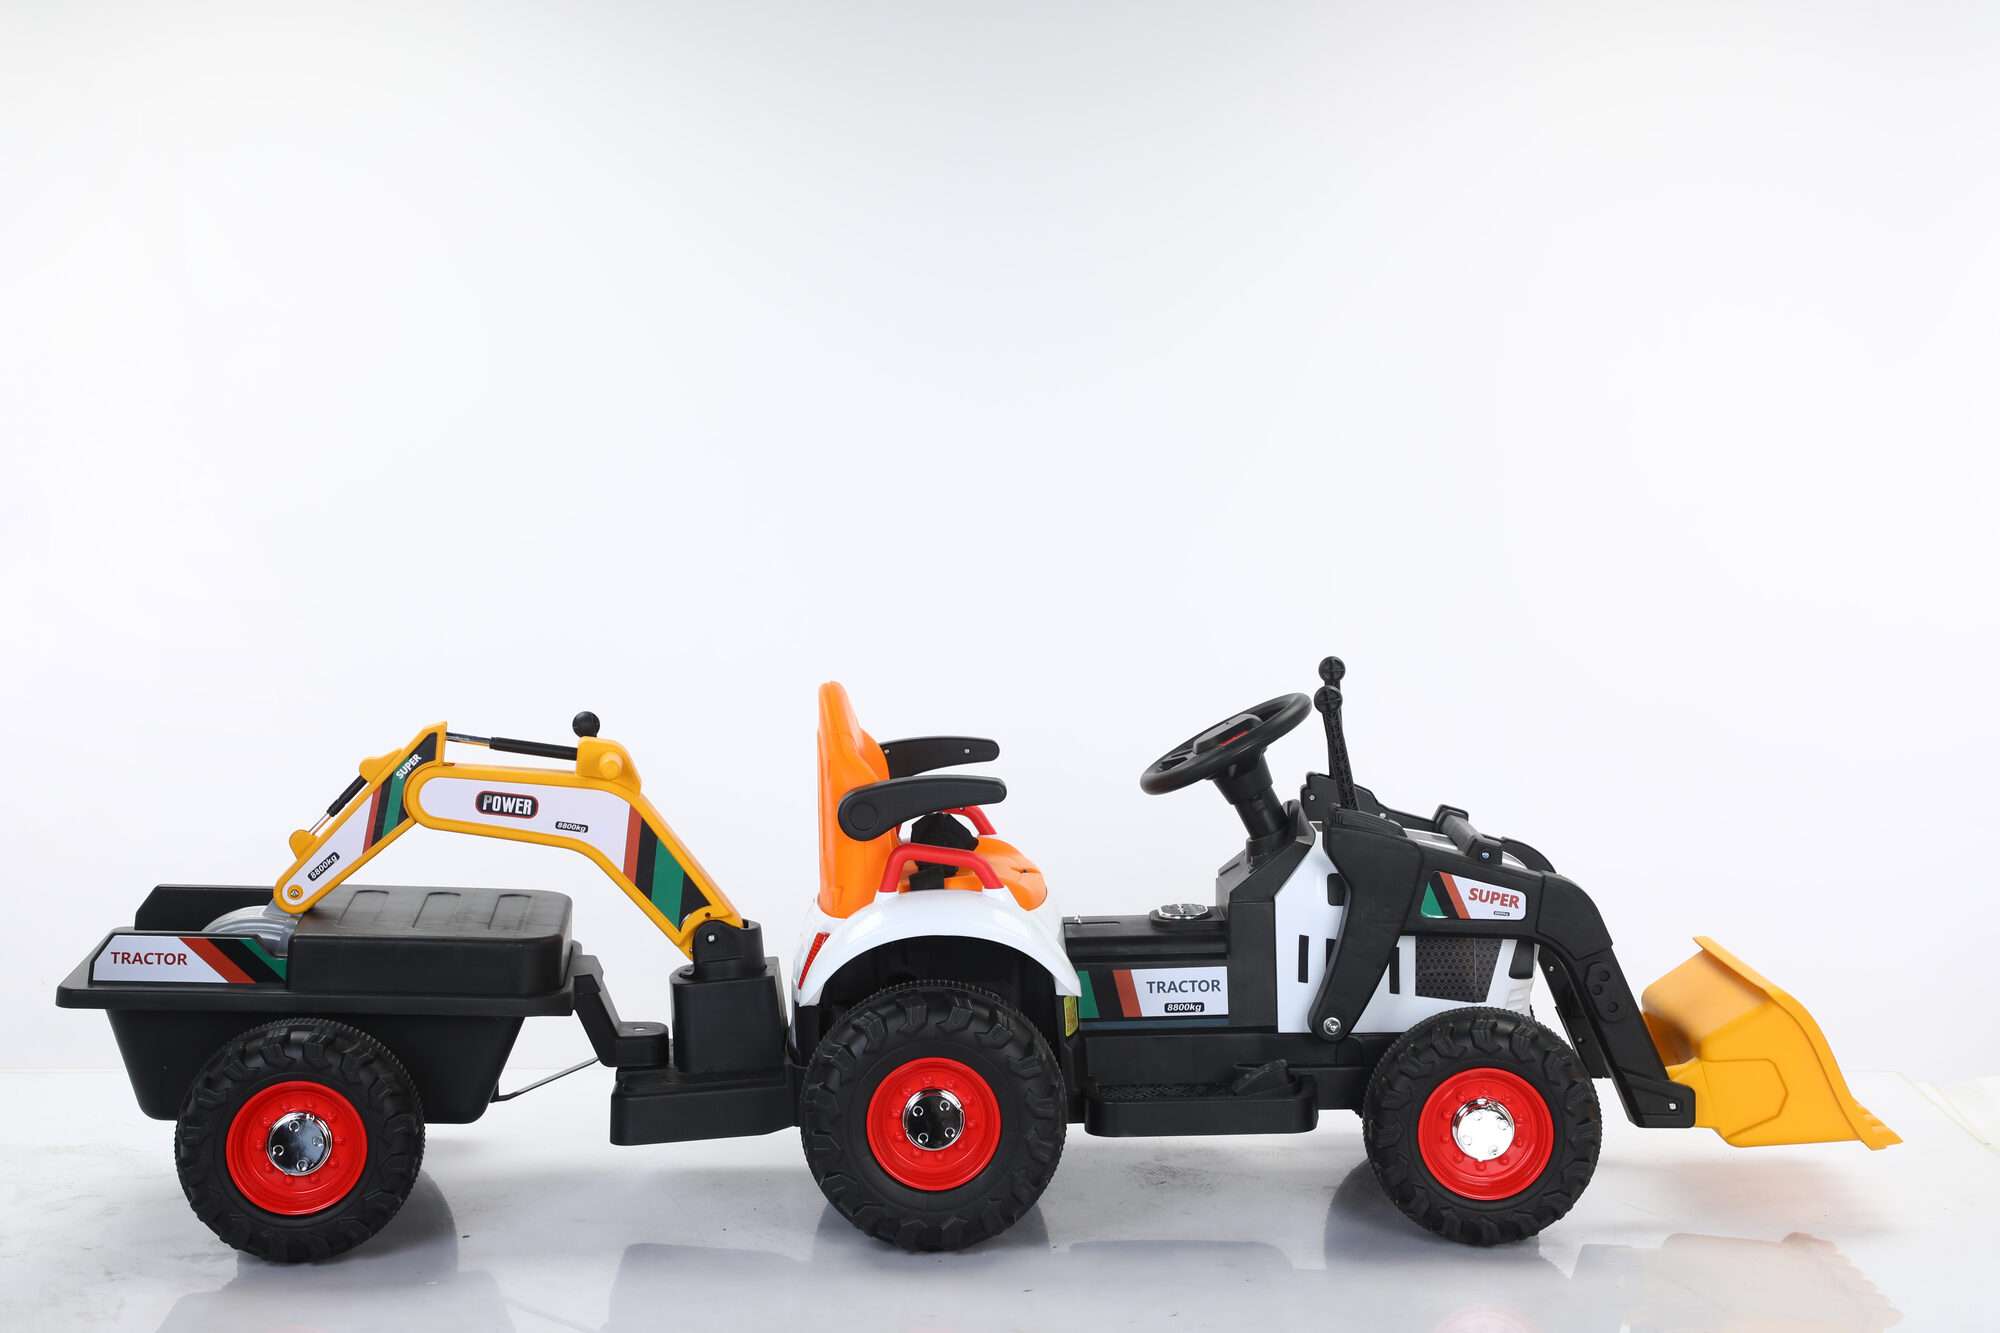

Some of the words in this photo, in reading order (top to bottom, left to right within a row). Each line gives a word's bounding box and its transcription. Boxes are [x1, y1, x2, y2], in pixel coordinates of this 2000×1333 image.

[396, 754, 422, 779] SUPER
[482, 794, 533, 815] POWER
[1468, 887, 1520, 909] SUPER
[110, 952, 188, 966] TRACTOR
[1146, 979, 1222, 994] TRACTOR
[1167, 1003, 1202, 1013] 8800kg
